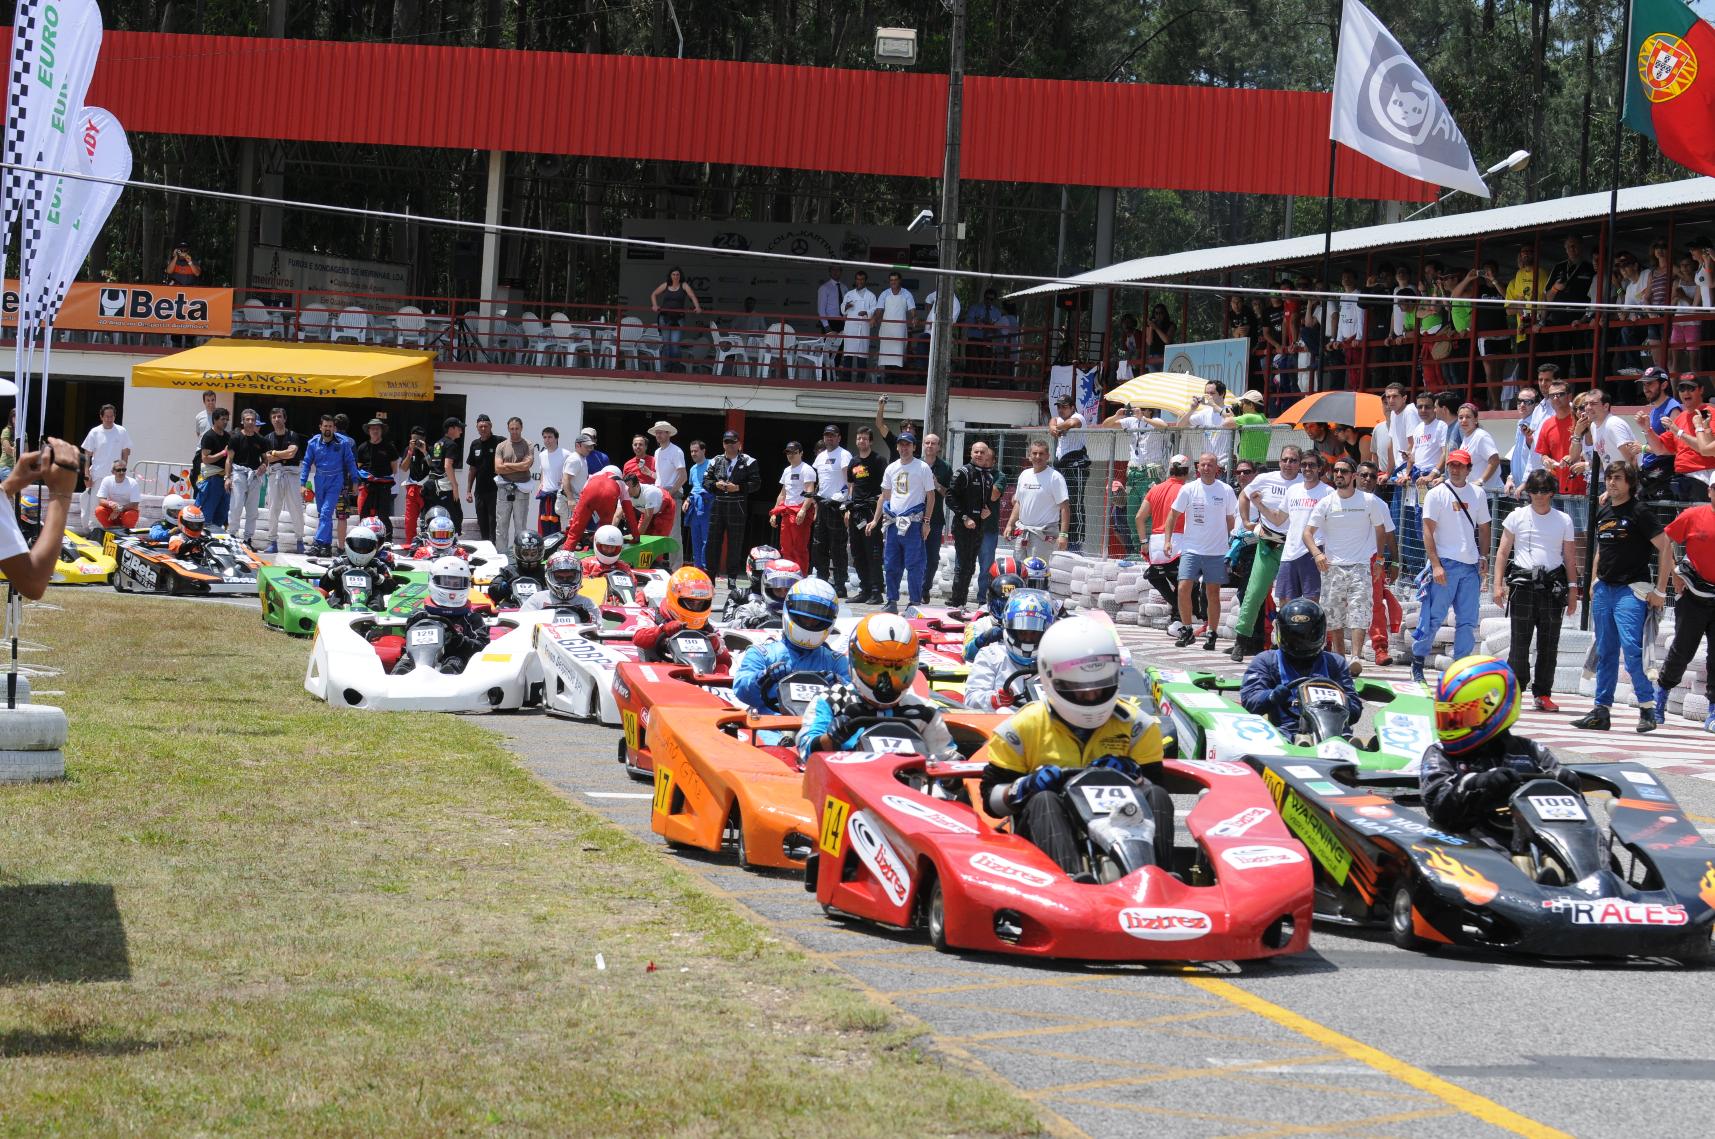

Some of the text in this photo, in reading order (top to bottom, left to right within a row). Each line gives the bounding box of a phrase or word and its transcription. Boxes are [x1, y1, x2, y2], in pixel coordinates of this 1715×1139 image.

[37, 4, 59, 90] EURO
[129, 288, 209, 322] Beta
[171, 379, 338, 396] www.pestronix.pt
[130, 554, 158, 585] Beta
[795, 684, 821, 693] 39
[1312, 688, 1337, 697] 115
[624, 713, 635, 746] 39
[877, 738, 903, 748] 17
[655, 769, 670, 809] 17
[1088, 787, 1128, 799] 74
[823, 800, 843, 850] 74
[1290, 793, 1345, 863] WARNING
[1123, 911, 1208, 930] liztrez
[1574, 903, 1688, 924] RACES
